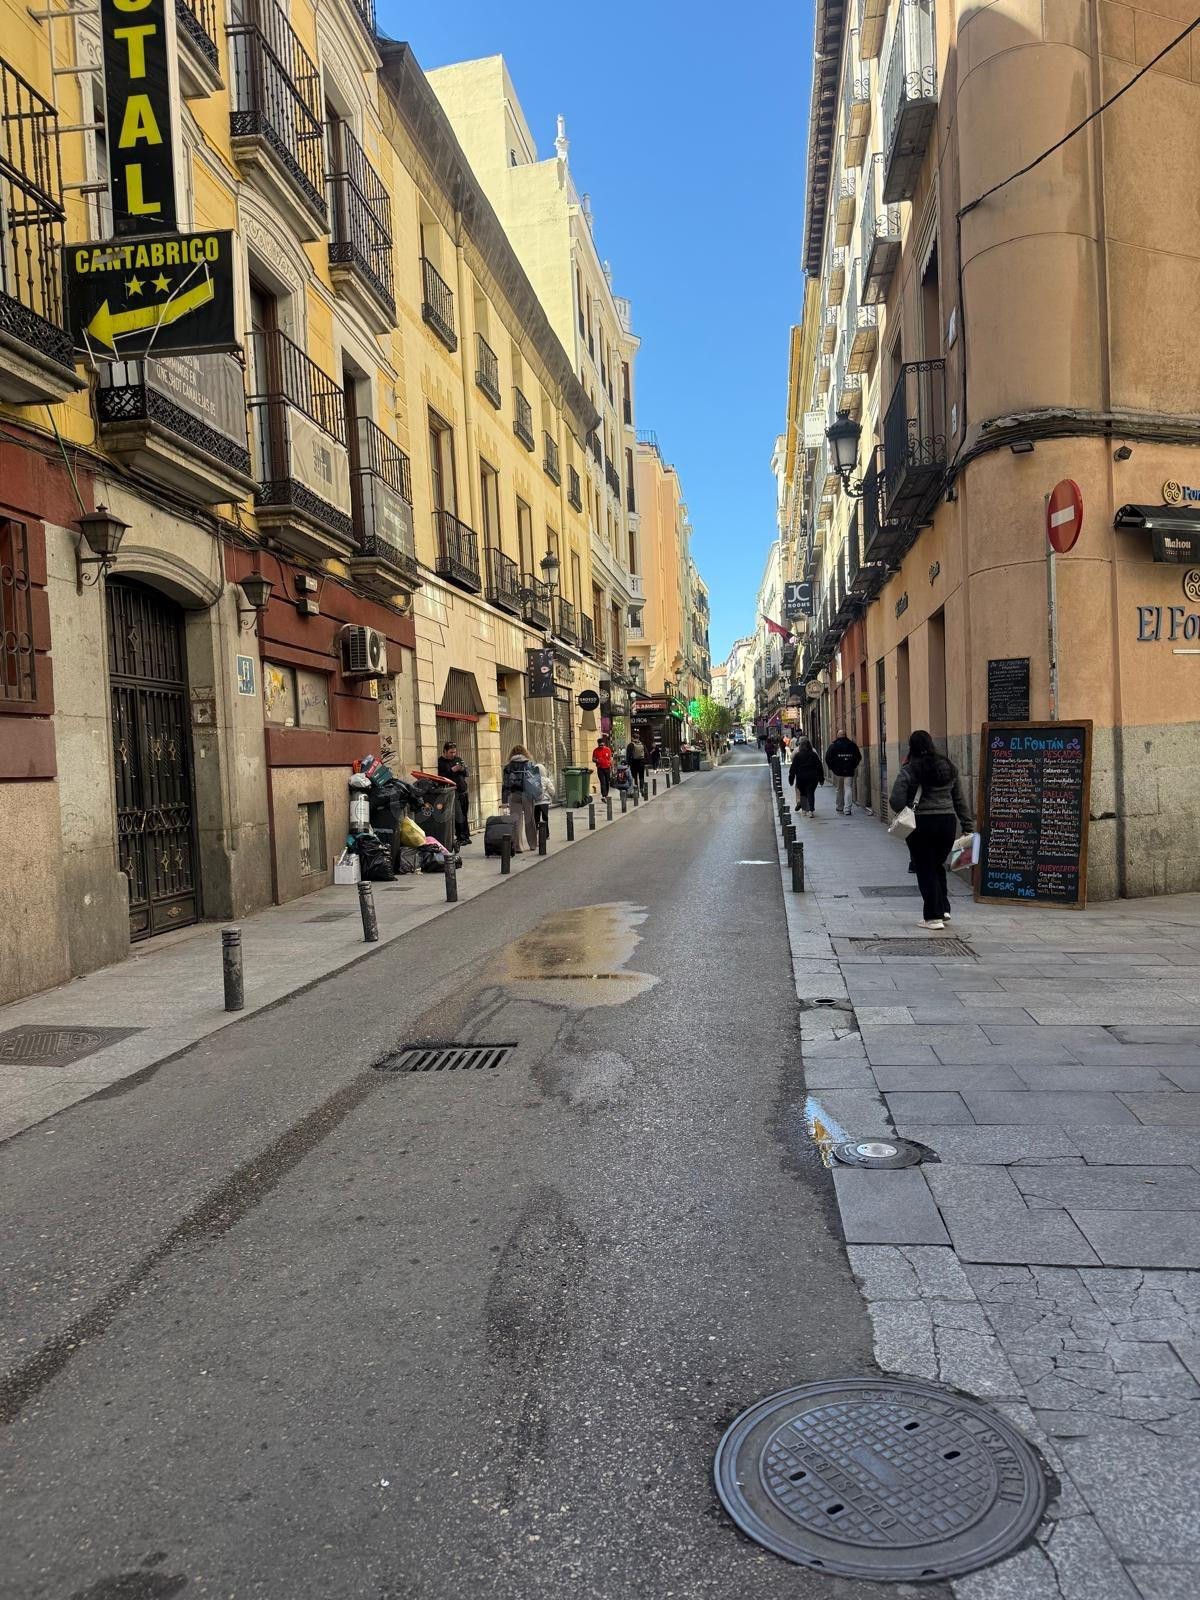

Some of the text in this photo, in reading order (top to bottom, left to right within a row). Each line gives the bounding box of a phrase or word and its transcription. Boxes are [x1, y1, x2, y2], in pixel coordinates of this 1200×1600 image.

[112, 0, 163, 215] TAL
[75, 237, 219, 274] CANTABRICO
[157, 364, 168, 384] ONE
[169, 372, 182, 393] SHOT
[1164, 538, 1191, 549] Mahou
[788, 583, 810, 603] JC
[1136, 606, 1200, 641] El Fo
[1011, 738, 1024, 750] EL
[987, 882, 1015, 891] COSAS
[988, 872, 1023, 882] MUCHAS
[1017, 885, 1036, 897] MÁS
[790, 1442, 898, 1530] REGISTRO
